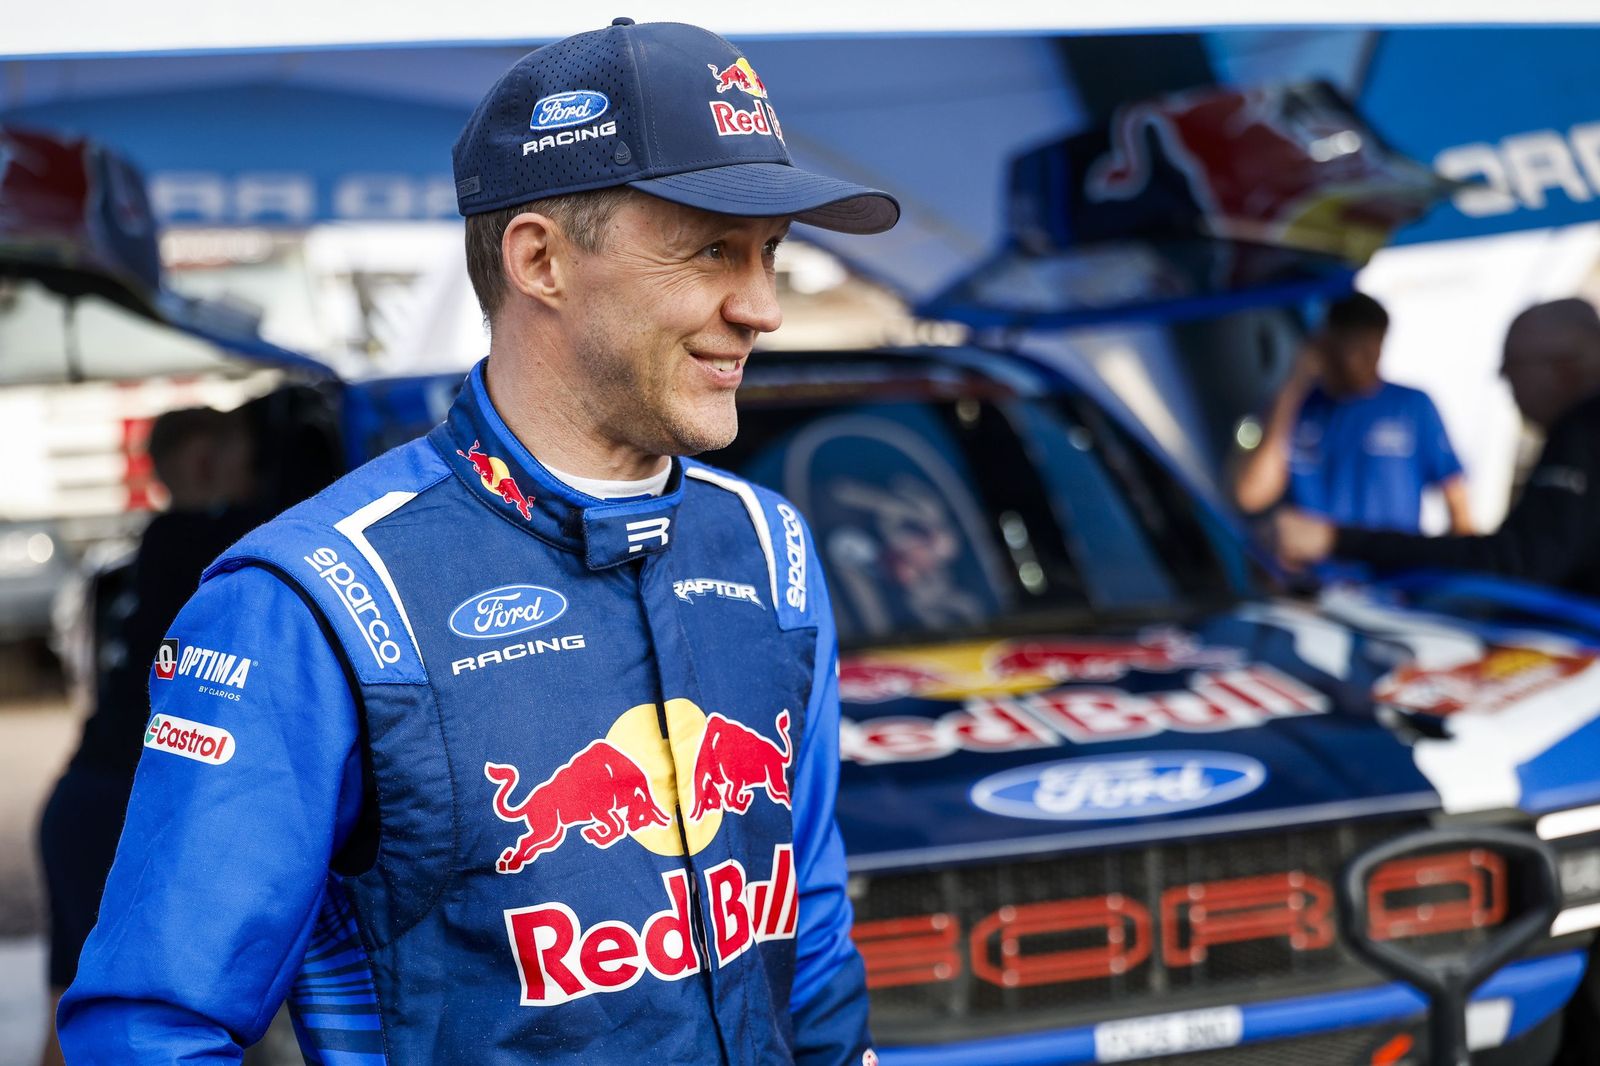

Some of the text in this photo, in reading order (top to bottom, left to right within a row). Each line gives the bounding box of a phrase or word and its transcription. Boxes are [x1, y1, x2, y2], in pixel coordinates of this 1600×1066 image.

[538, 95, 591, 124] Ford
[709, 99, 772, 136] Red
[522, 121, 617, 156] RACING
[777, 503, 807, 613] sparco
[305, 547, 401, 669] sparco
[474, 592, 545, 633] Ford
[673, 578, 767, 611] RAPTOR
[451, 634, 586, 676] RACING
[198, 685, 241, 702] BY CLARIOS
[838, 691, 1060, 767] ed
[1025, 664, 1332, 744] Bull
[156, 720, 228, 760] Castrol
[1034, 757, 1216, 814] Ford
[503, 868, 702, 1007] Red
